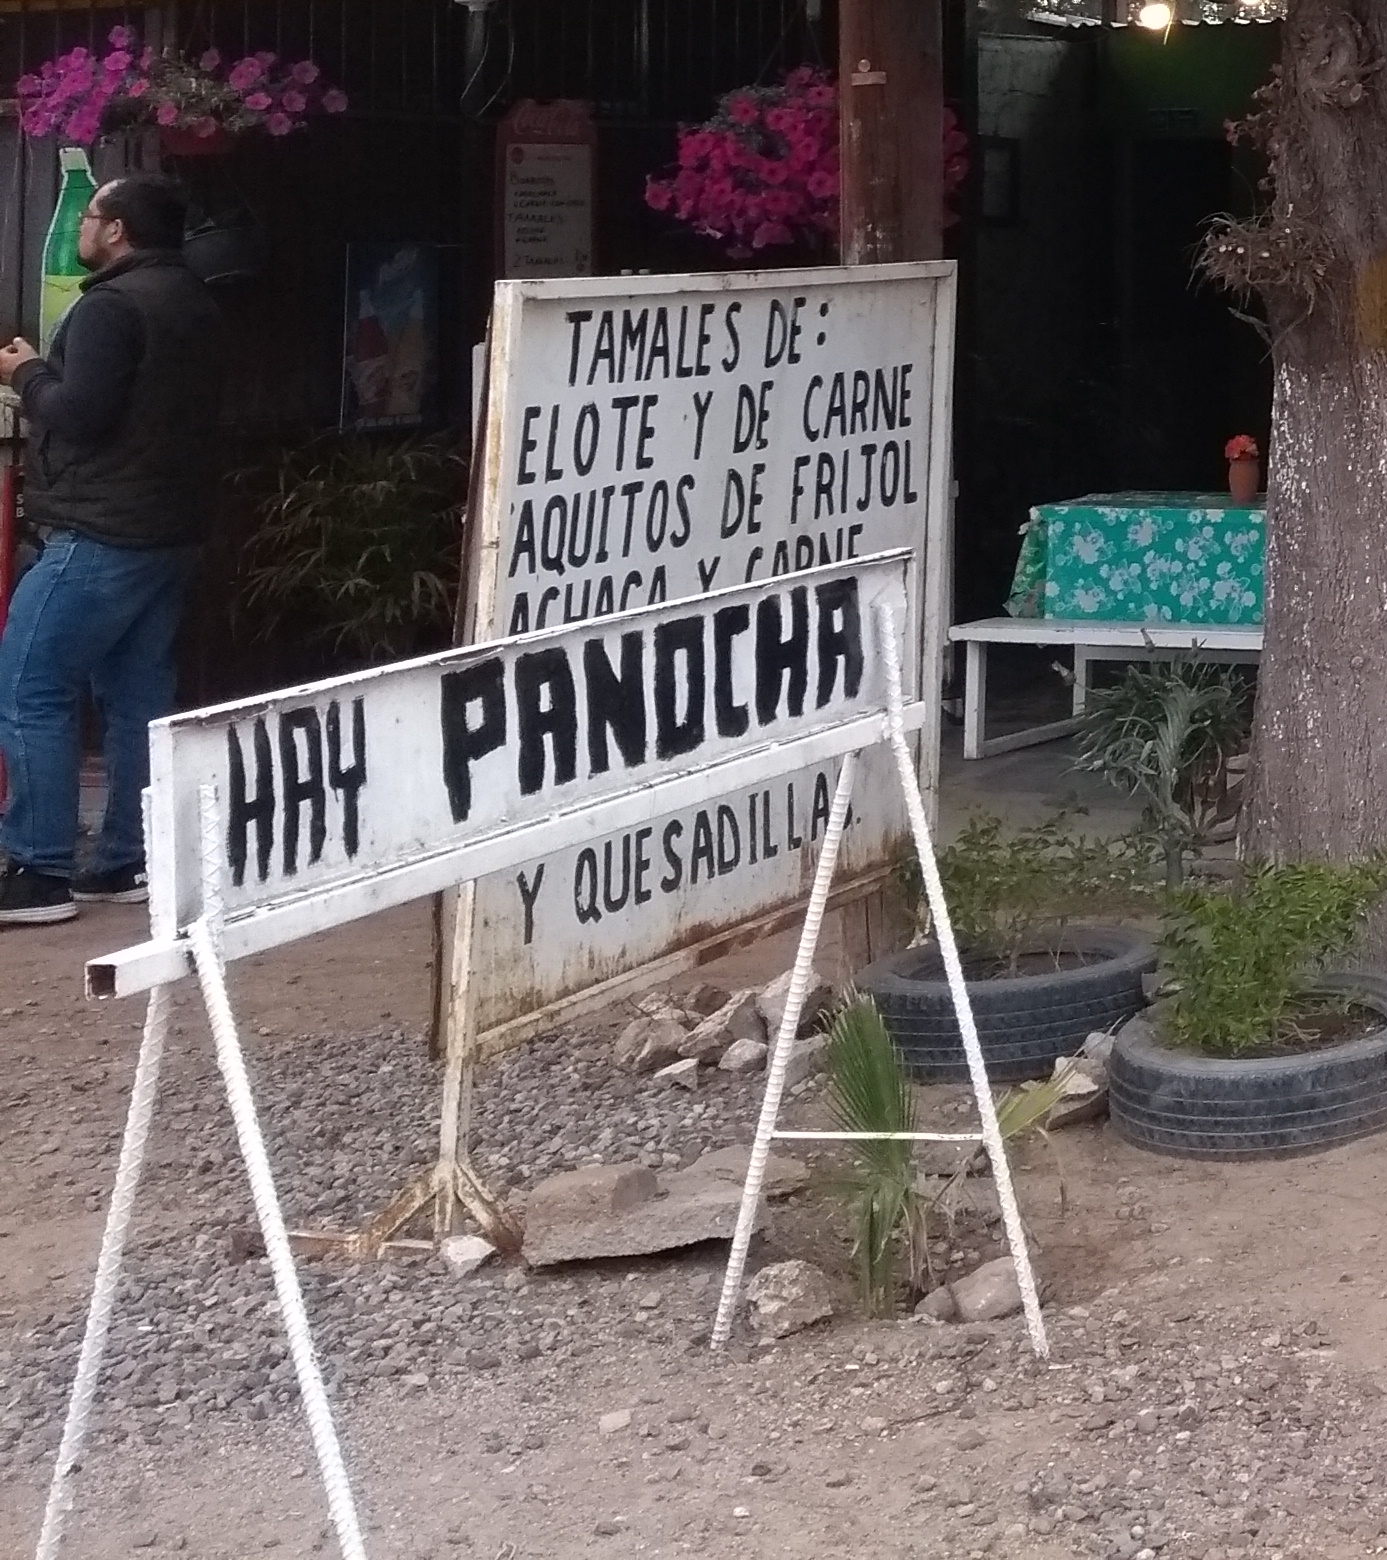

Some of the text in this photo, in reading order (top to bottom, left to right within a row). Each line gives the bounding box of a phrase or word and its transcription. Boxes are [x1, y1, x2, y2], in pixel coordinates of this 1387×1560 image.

[566, 301, 742, 388] TAMALES
[517, 363, 914, 486] ELOTE Y DE CARNE
[508, 439, 919, 578] AQUITOS DE FRIJOL
[508, 564, 667, 635] ACHACA
[226, 576, 864, 887] HAY PANOCHA
[515, 862, 546, 946] Y
